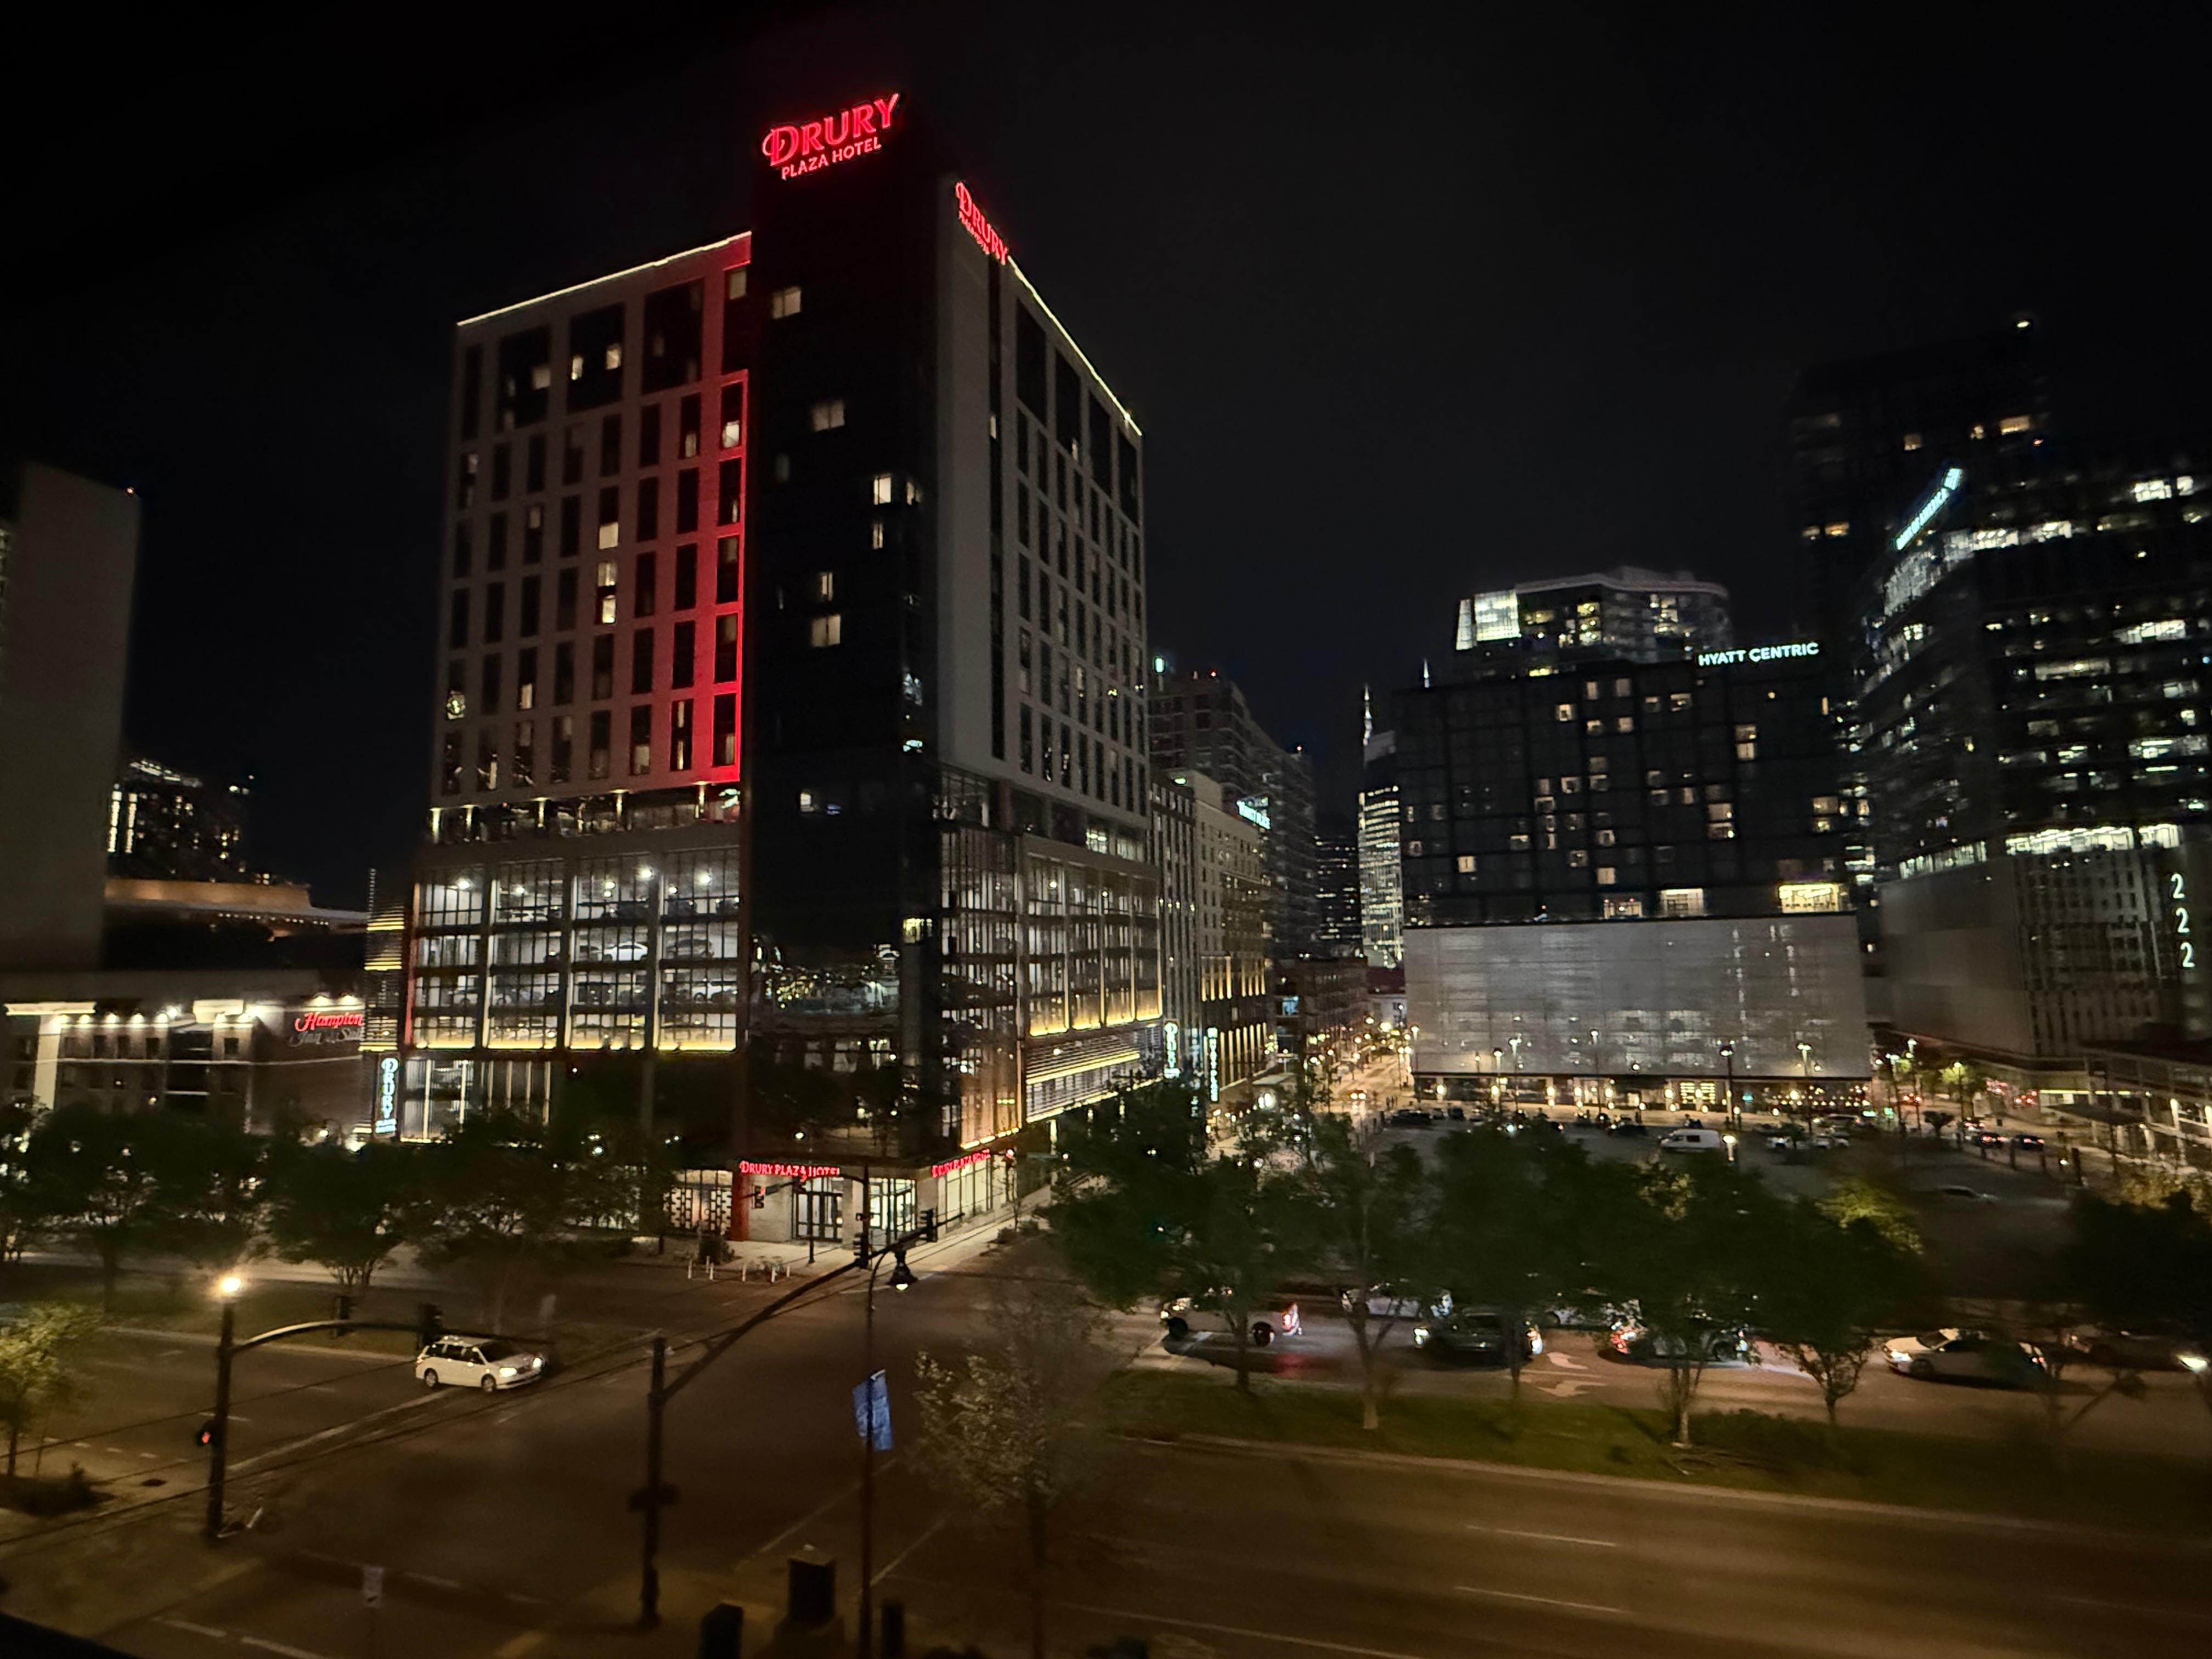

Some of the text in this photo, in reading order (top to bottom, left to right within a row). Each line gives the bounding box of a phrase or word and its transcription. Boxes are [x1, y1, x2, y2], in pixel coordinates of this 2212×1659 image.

[762, 93, 901, 166] DRURY
[781, 137, 882, 180] PLAZA HOTEL
[956, 181, 1008, 265] DRURY
[1698, 642, 1819, 666] HYATT CENTRIC
[381, 1058, 398, 1119] DRURY
[739, 1160, 772, 1175] DRURY
